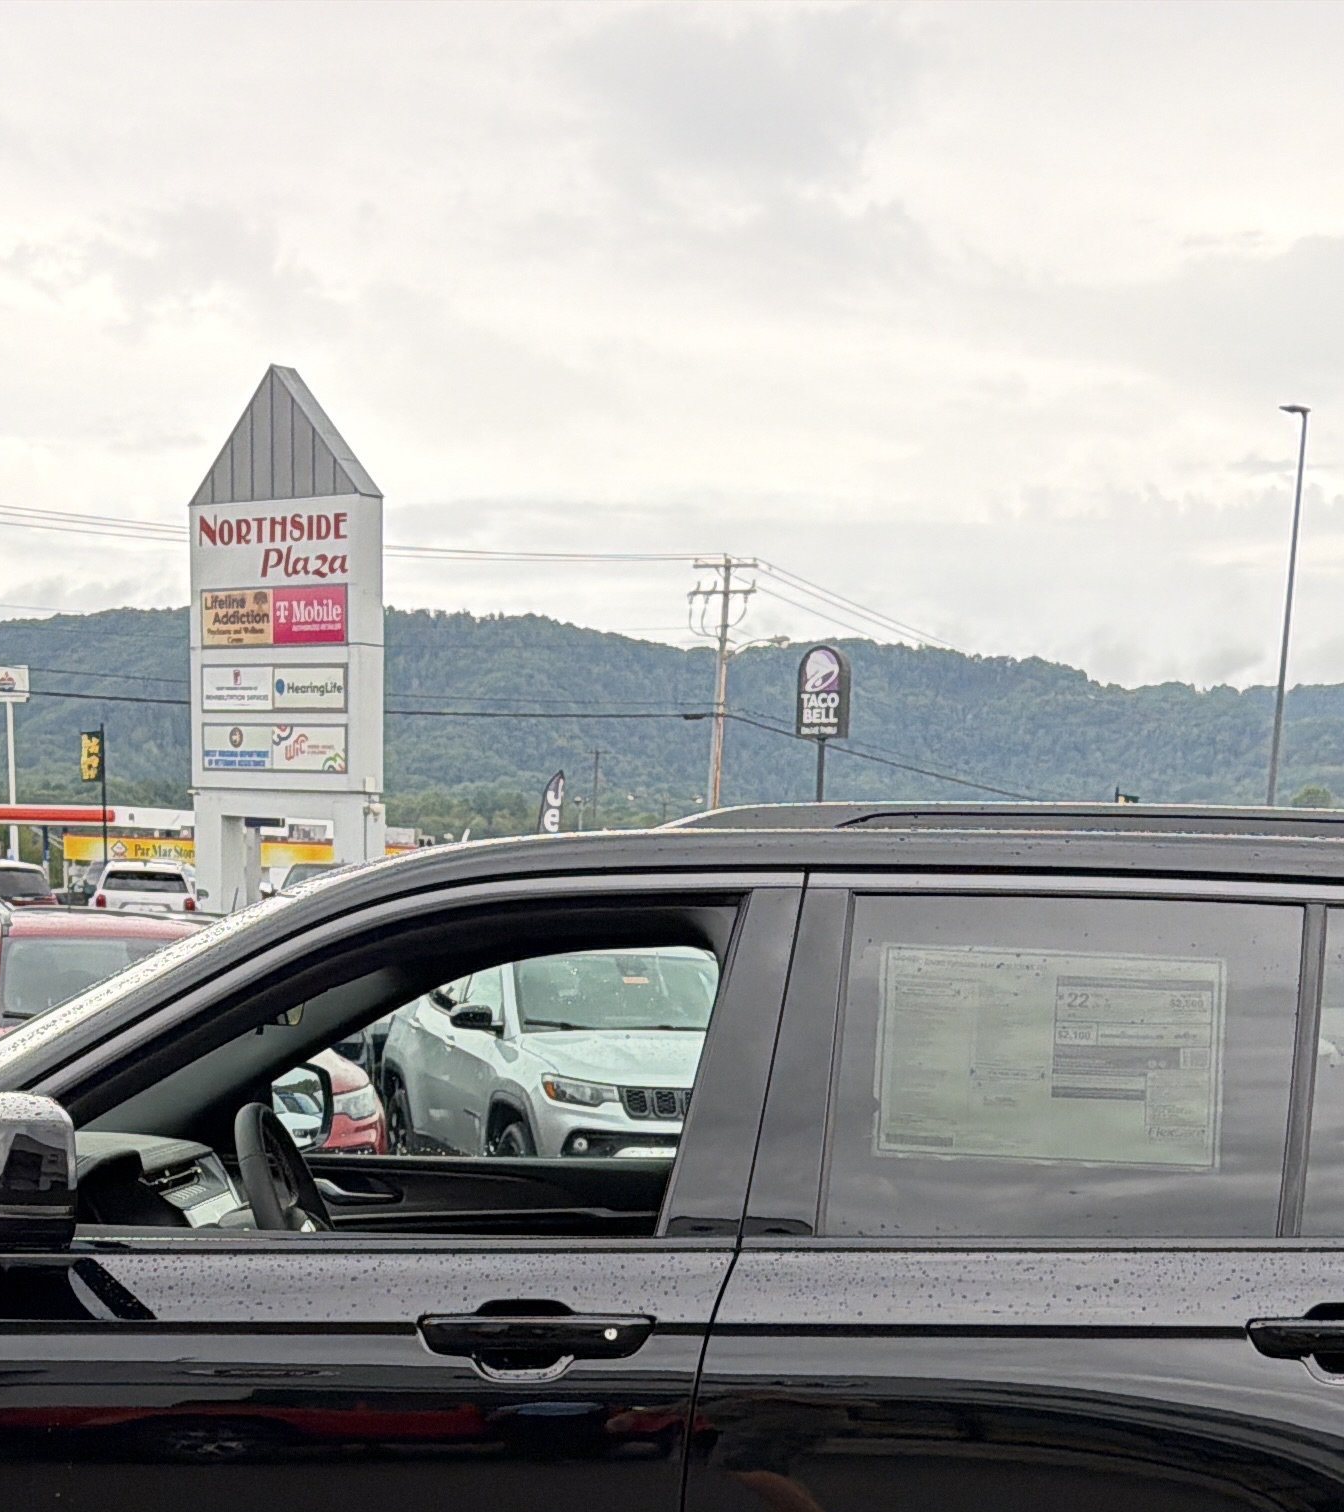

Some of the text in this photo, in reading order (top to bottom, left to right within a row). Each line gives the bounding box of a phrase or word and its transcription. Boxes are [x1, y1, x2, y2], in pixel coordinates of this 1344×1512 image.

[199, 512, 348, 547] NORTHSIDE
[261, 545, 349, 579] Plaza
[204, 591, 247, 611] Lifeline
[212, 609, 270, 626] Addiction
[286, 681, 344, 697] HearingLife
[800, 692, 840, 708] TACO
[802, 707, 839, 724] BELL
